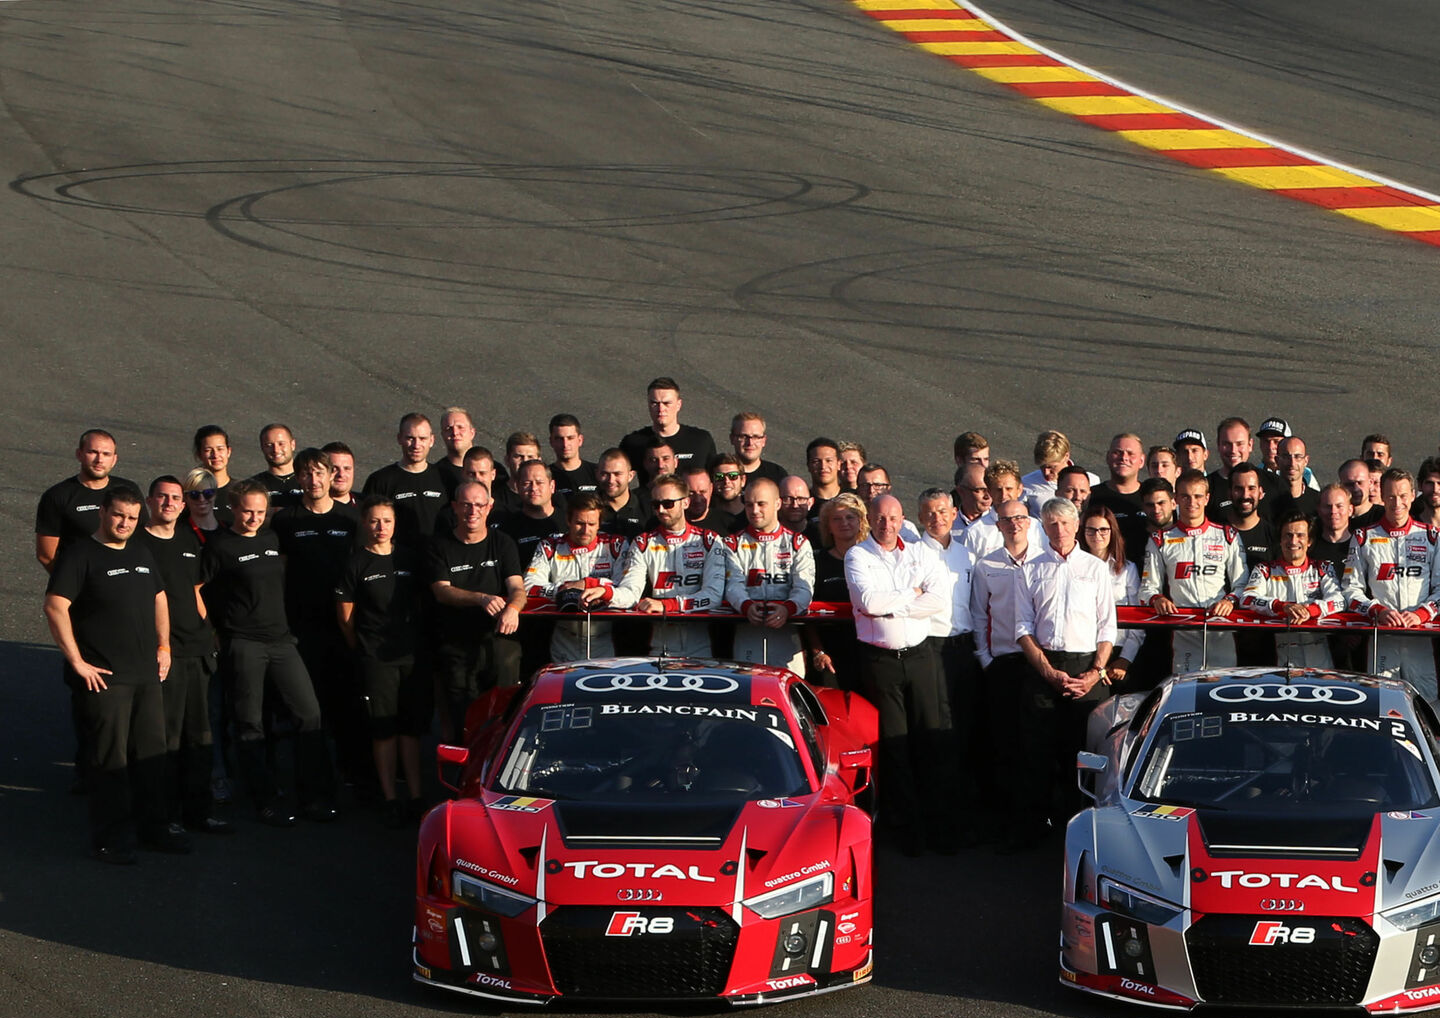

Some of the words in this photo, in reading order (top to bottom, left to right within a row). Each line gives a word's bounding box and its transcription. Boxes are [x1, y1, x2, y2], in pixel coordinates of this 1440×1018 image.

[755, 572, 789, 584] R8
[1182, 564, 1218, 577] R8
[1385, 564, 1423, 578] R8
[662, 573, 700, 587] R8
[690, 598, 711, 608] R8
[600, 704, 758, 721] BLANCPAIN
[768, 714, 778, 727] 1
[1229, 712, 1381, 730] BLANCPAIN
[1391, 721, 1405, 738] 2
[456, 858, 488, 875] quattro
[488, 870, 519, 886] GmbH
[564, 860, 716, 883] TOTAL
[764, 870, 801, 888] quattro
[801, 860, 831, 875] GmbH
[1210, 870, 1358, 893] TOTAL
[1405, 883, 1439, 899] quattro
[614, 914, 675, 935] R8
[1257, 924, 1316, 944] R8
[475, 972, 512, 989] TOTAL
[765, 976, 811, 991] TOTAL
[1120, 977, 1155, 995] TOTAL
